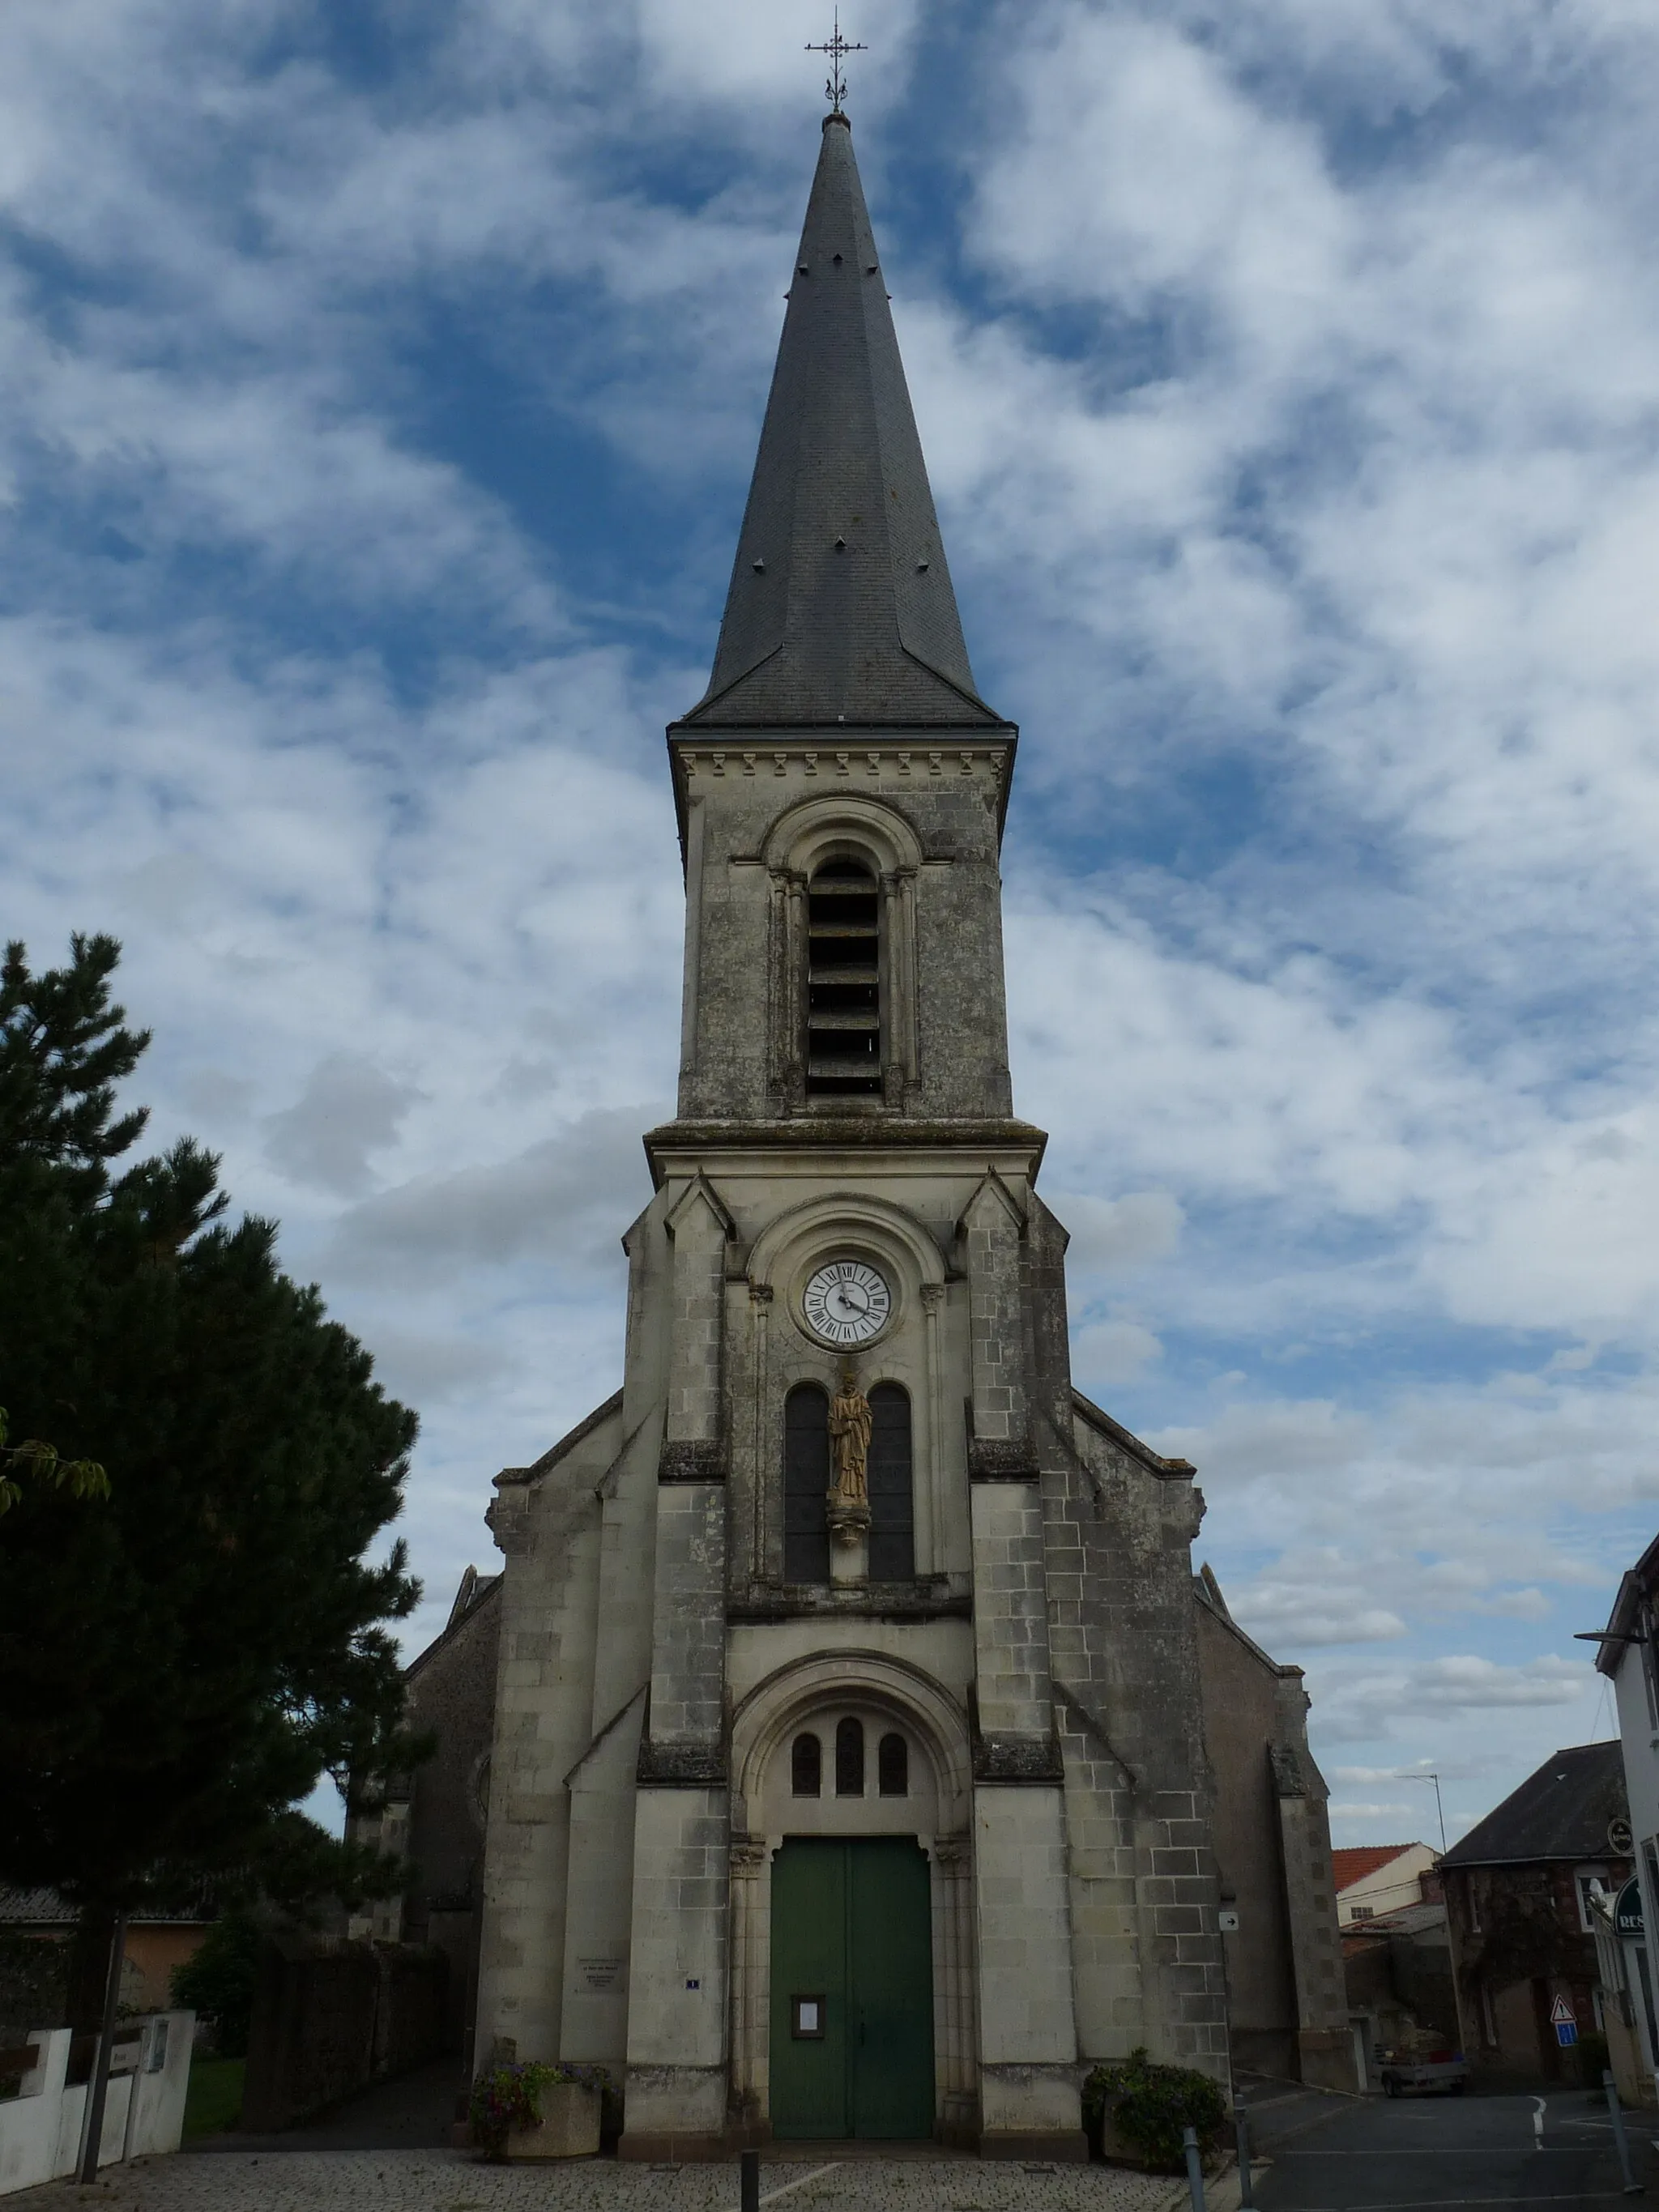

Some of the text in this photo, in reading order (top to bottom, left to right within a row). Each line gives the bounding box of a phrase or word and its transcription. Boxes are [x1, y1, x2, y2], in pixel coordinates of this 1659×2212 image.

[825, 1270, 837, 1281] XI
[842, 1266, 852, 1277] XII
[859, 1271, 867, 1281] I
[868, 1282, 881, 1291] II
[812, 1311, 825, 1326] VIII
[870, 1312, 881, 1321] IV
[825, 1323, 837, 1336] VII
[843, 1327, 851, 1339] VI
[860, 1324, 868, 1334] V
